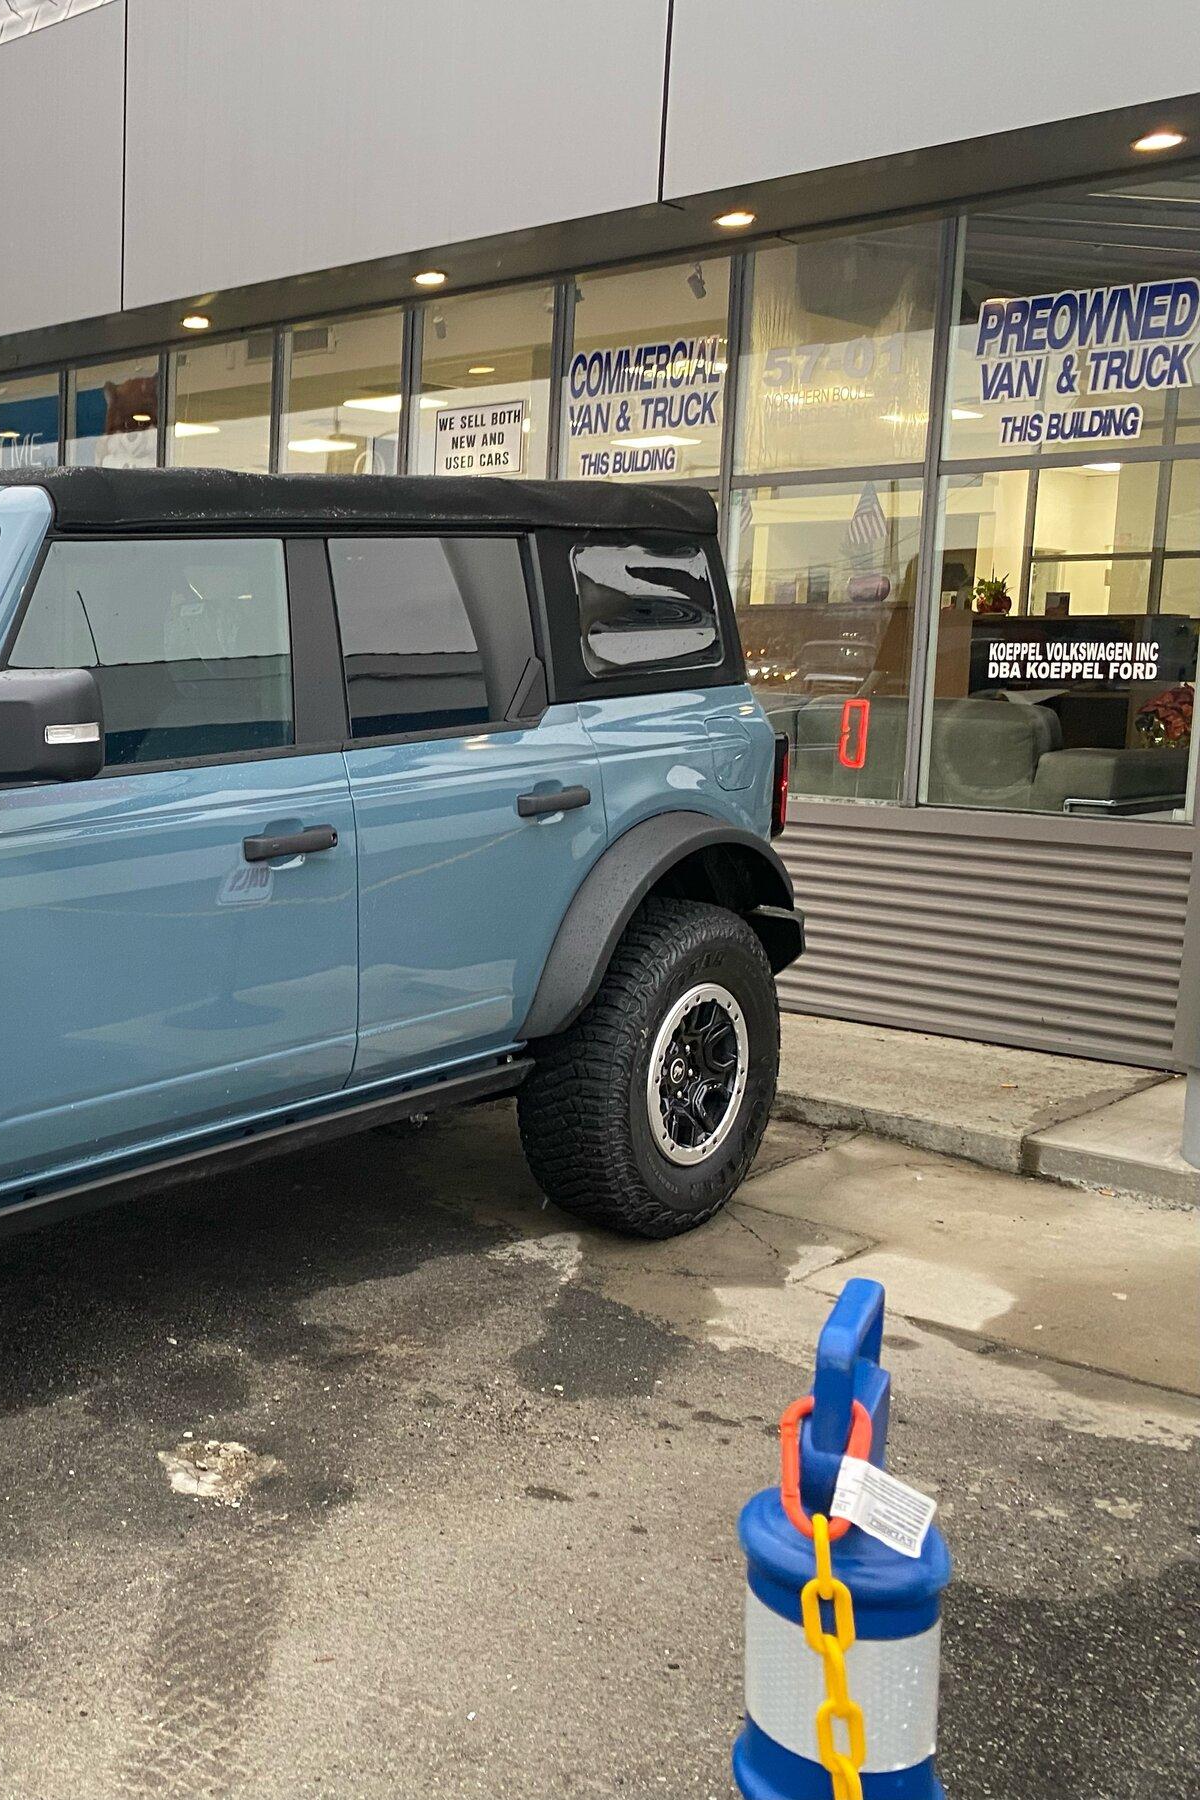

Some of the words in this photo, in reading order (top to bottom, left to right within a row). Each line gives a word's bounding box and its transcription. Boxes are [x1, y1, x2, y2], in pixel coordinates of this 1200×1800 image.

[976, 280, 1200, 356] PREOWNED
[570, 334, 721, 399] COMMERCIAL
[981, 358, 1042, 400] VAN
[1056, 354, 1076, 394] &
[1090, 343, 1193, 391] TRUCK
[764, 388, 830, 408] NORTHERN
[439, 416, 455, 431] WE
[460, 413, 486, 429] SELL
[490, 409, 521, 426] BOTH
[569, 403, 611, 436] VAN
[615, 400, 631, 432] &
[641, 391, 719, 430] TRUCK
[1001, 413, 1043, 443] THIS
[1046, 406, 1139, 441] BUILDING
[451, 434, 476, 450] NEW
[481, 431, 505, 447] AND
[445, 455, 474, 470] USED
[479, 451, 509, 467] CARS
[581, 451, 609, 476] THIS
[612, 446, 676, 473] BUILDING
[989, 642, 1043, 661] KOEPPEL
[1046, 642, 1132, 662] VOLKSWAGEN
[1135, 642, 1159, 662] INC
[987, 662, 1022, 679] DBA
[1026, 662, 1104, 680] KOEPPEL
[1109, 662, 1158, 680] FORD
